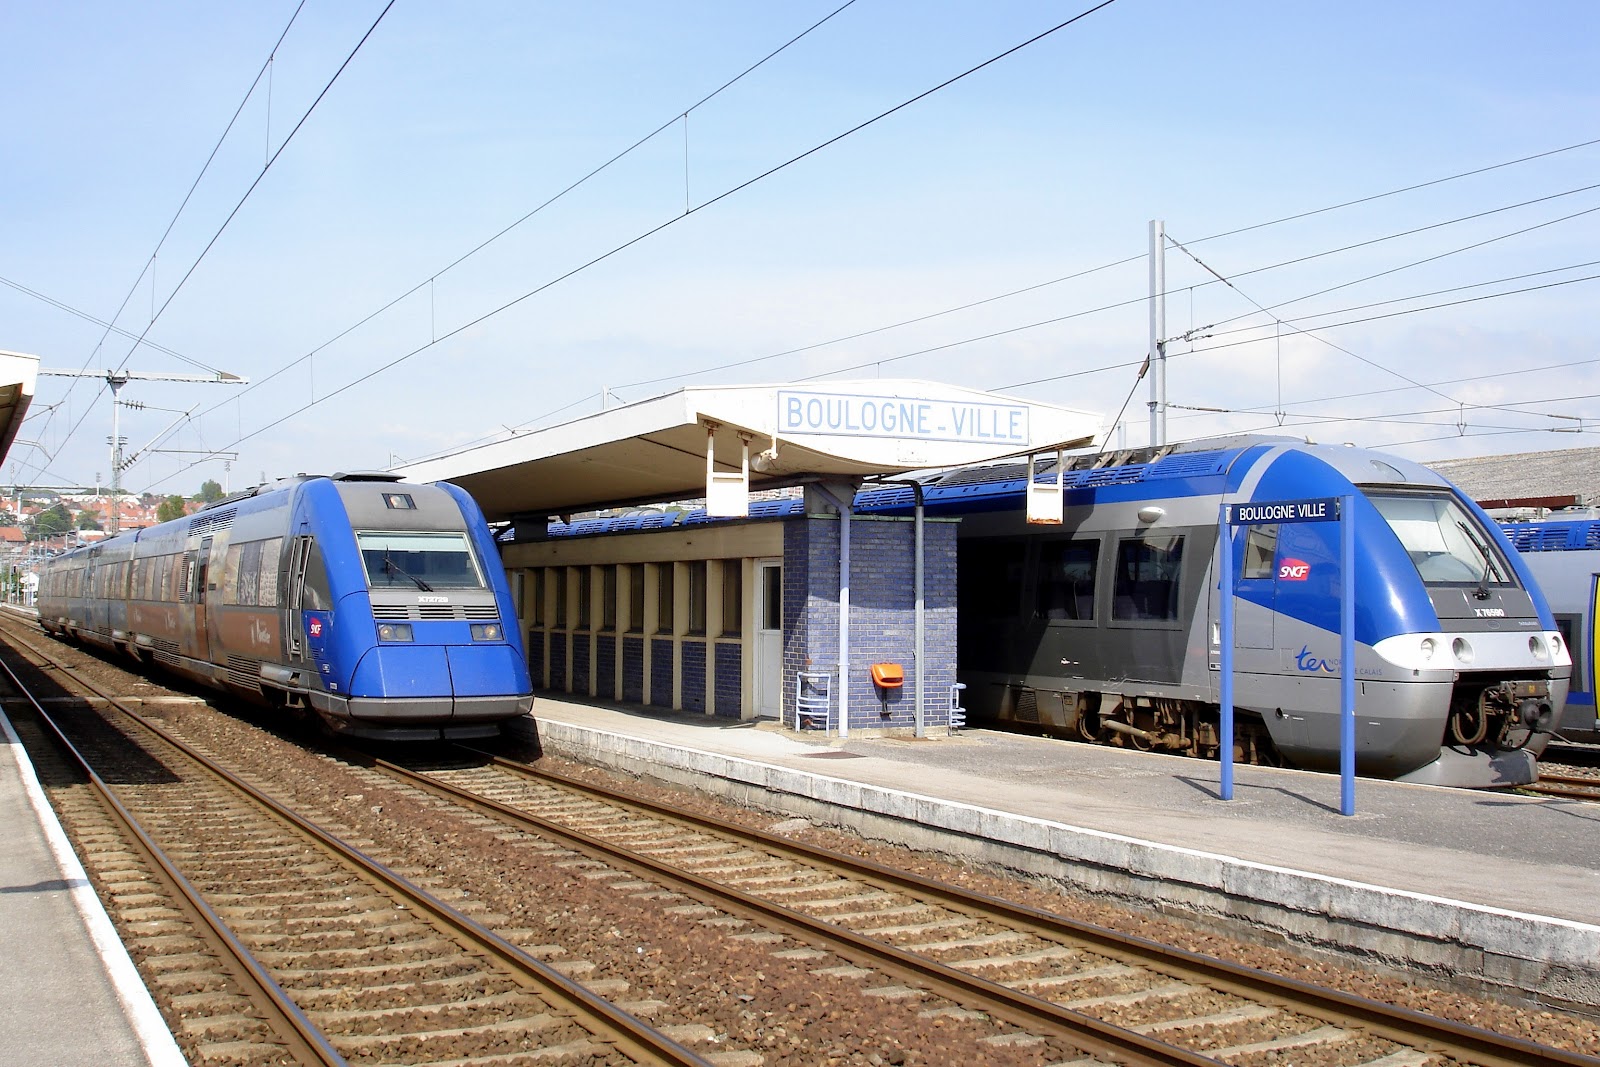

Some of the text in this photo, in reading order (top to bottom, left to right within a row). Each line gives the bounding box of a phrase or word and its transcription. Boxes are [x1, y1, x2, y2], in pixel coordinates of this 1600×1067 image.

[1240, 503, 1326, 521] BOULOGNE VILLE
[1279, 566, 1309, 577] SNCF
[1360, 668, 1383, 676] CALAIS
